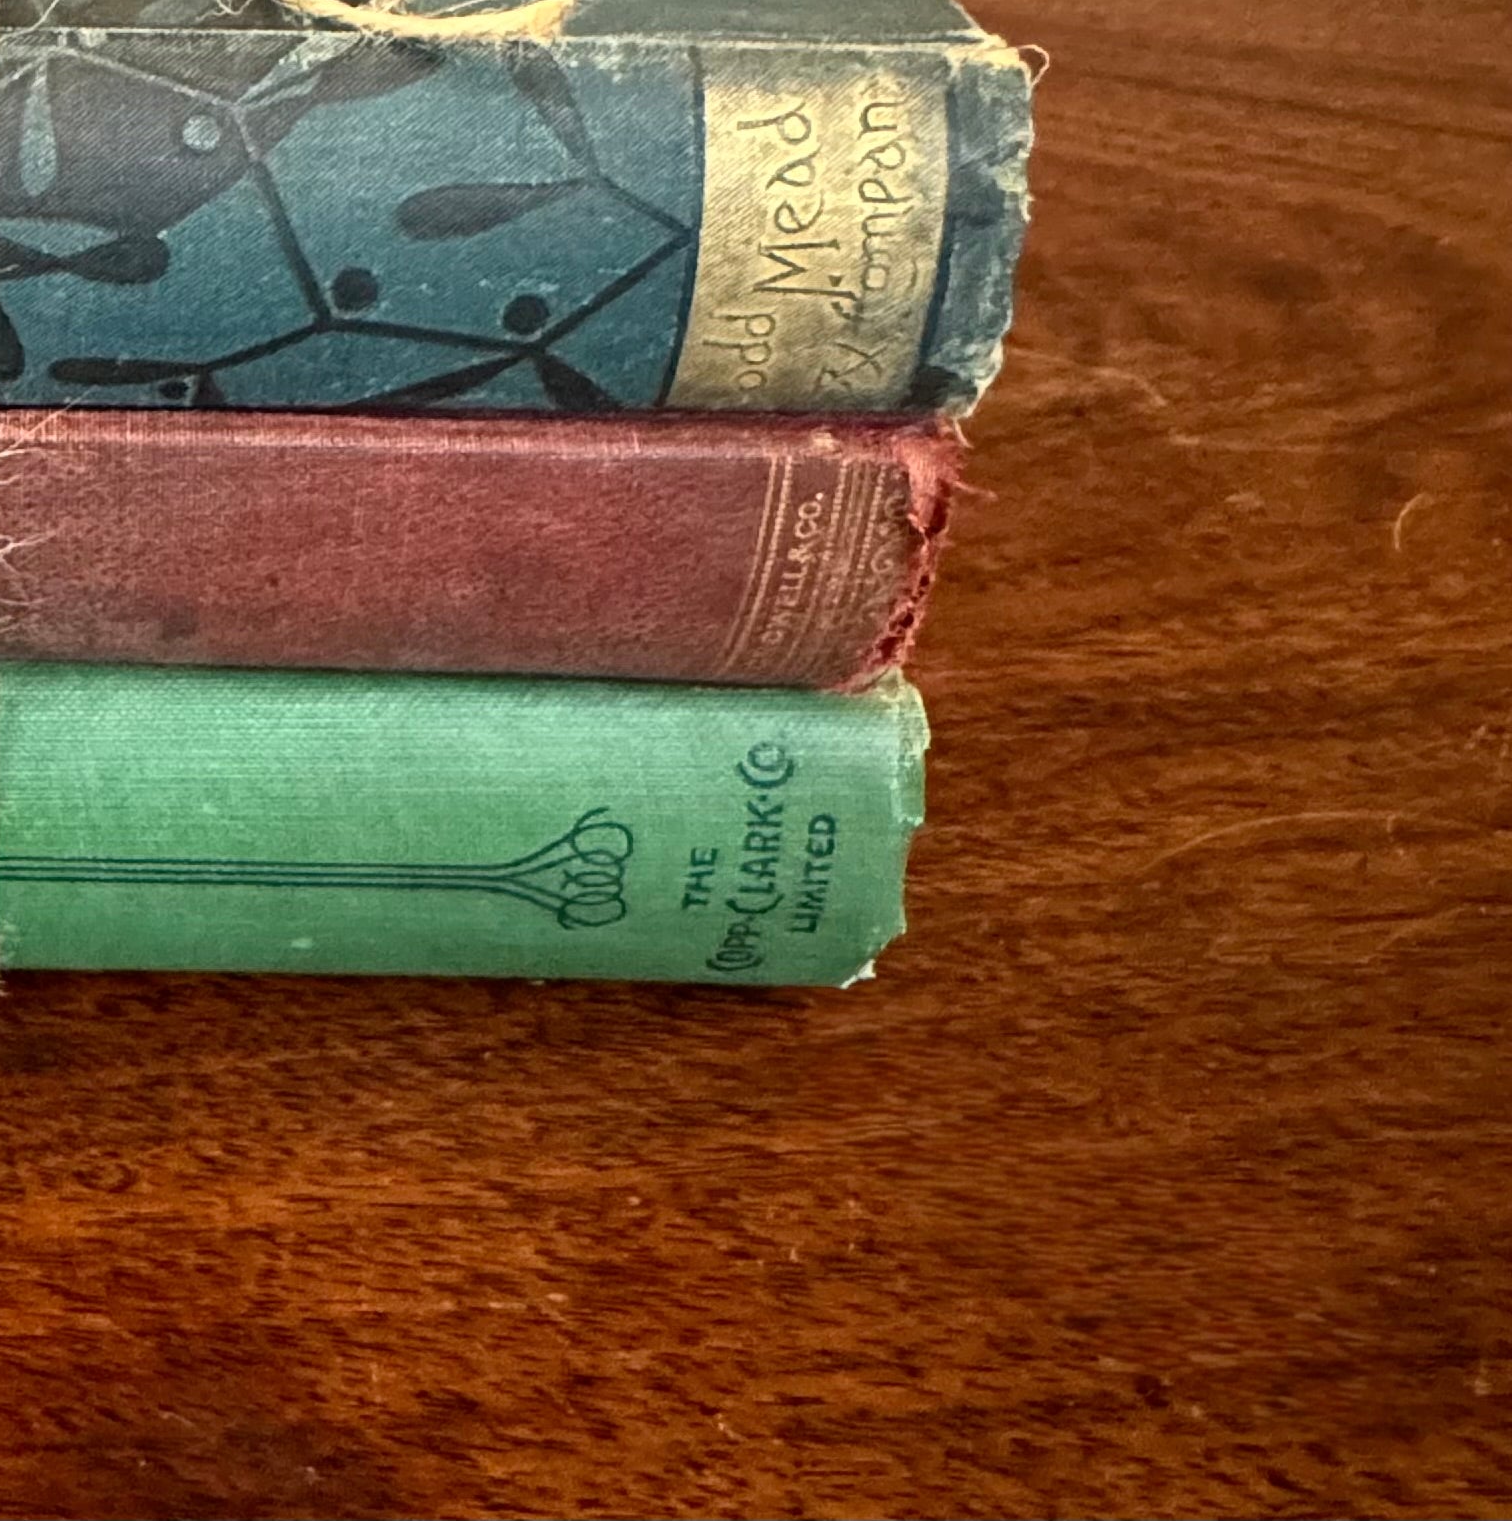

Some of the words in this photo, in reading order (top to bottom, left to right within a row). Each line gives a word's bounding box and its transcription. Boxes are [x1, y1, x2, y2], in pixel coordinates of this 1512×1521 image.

[736, 97, 858, 301] Mead
[701, 306, 779, 392] odd
[681, 846, 720, 910] THE
[786, 813, 837, 934] LIMITED
